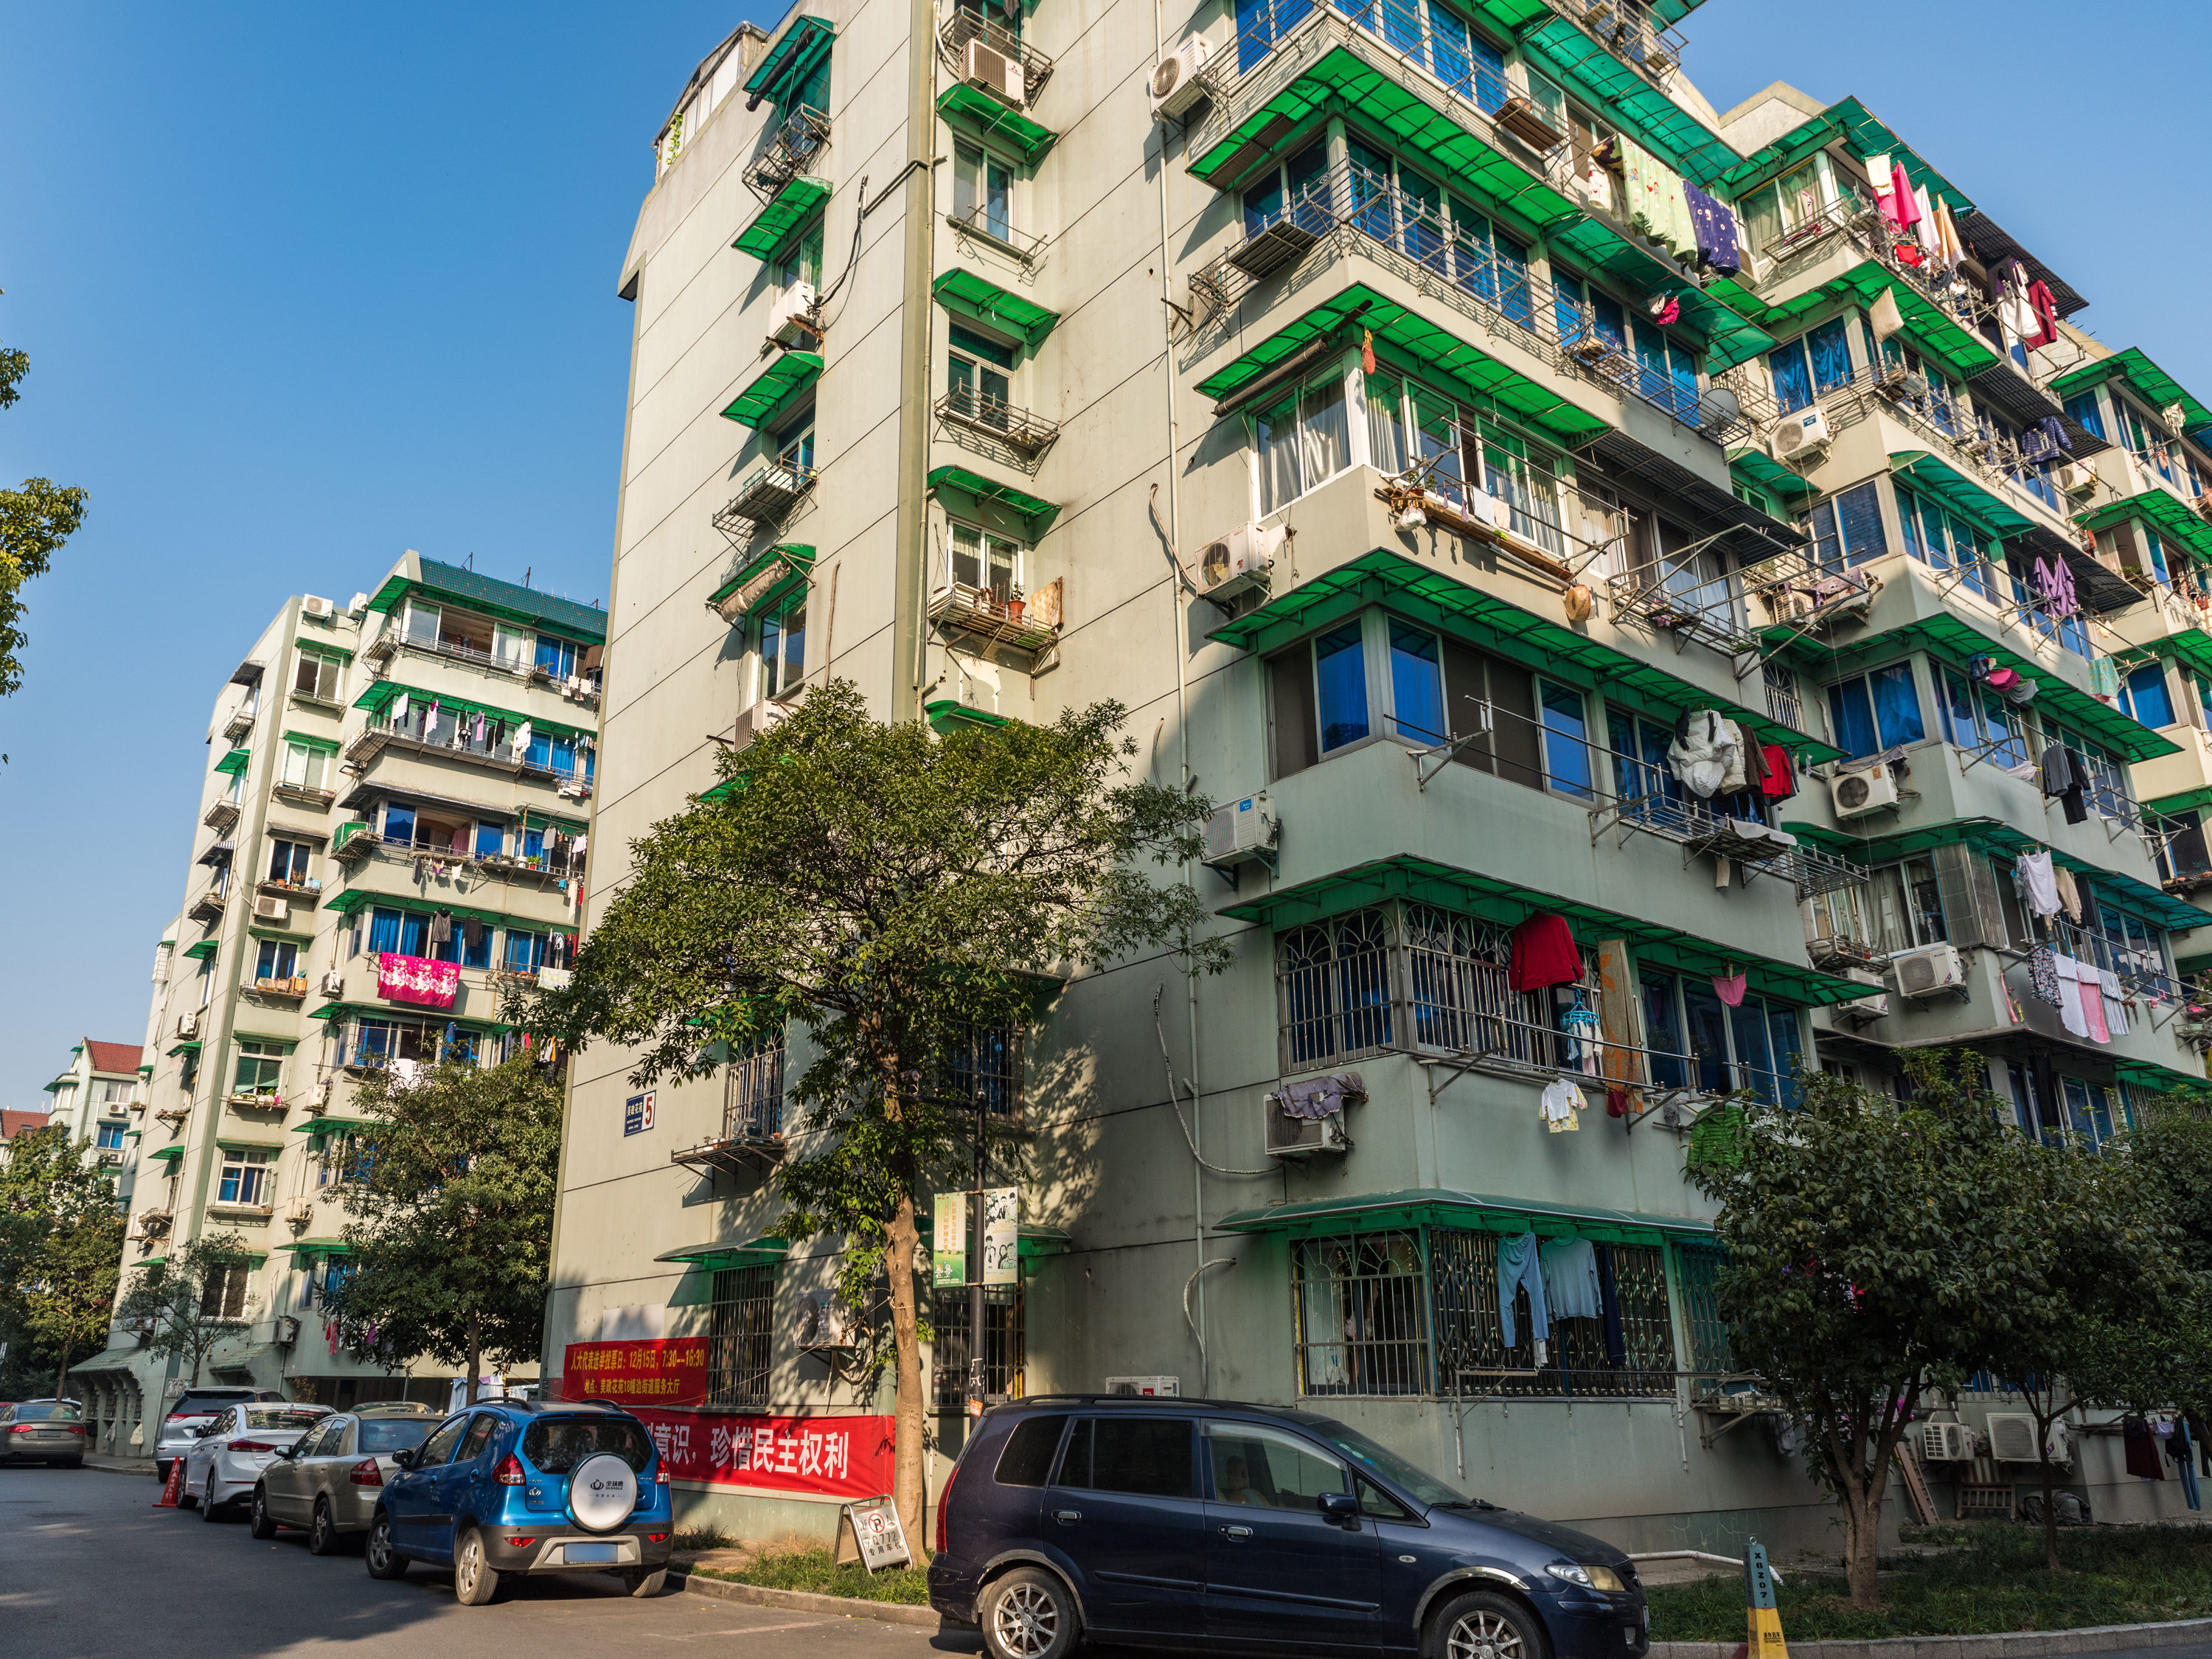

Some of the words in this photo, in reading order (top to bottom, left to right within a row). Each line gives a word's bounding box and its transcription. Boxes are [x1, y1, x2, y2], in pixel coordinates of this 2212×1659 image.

[627, 1102, 643, 1116] 美政花苑
[645, 1096, 653, 1125] 5
[869, 1541, 902, 1557] 专用车位
